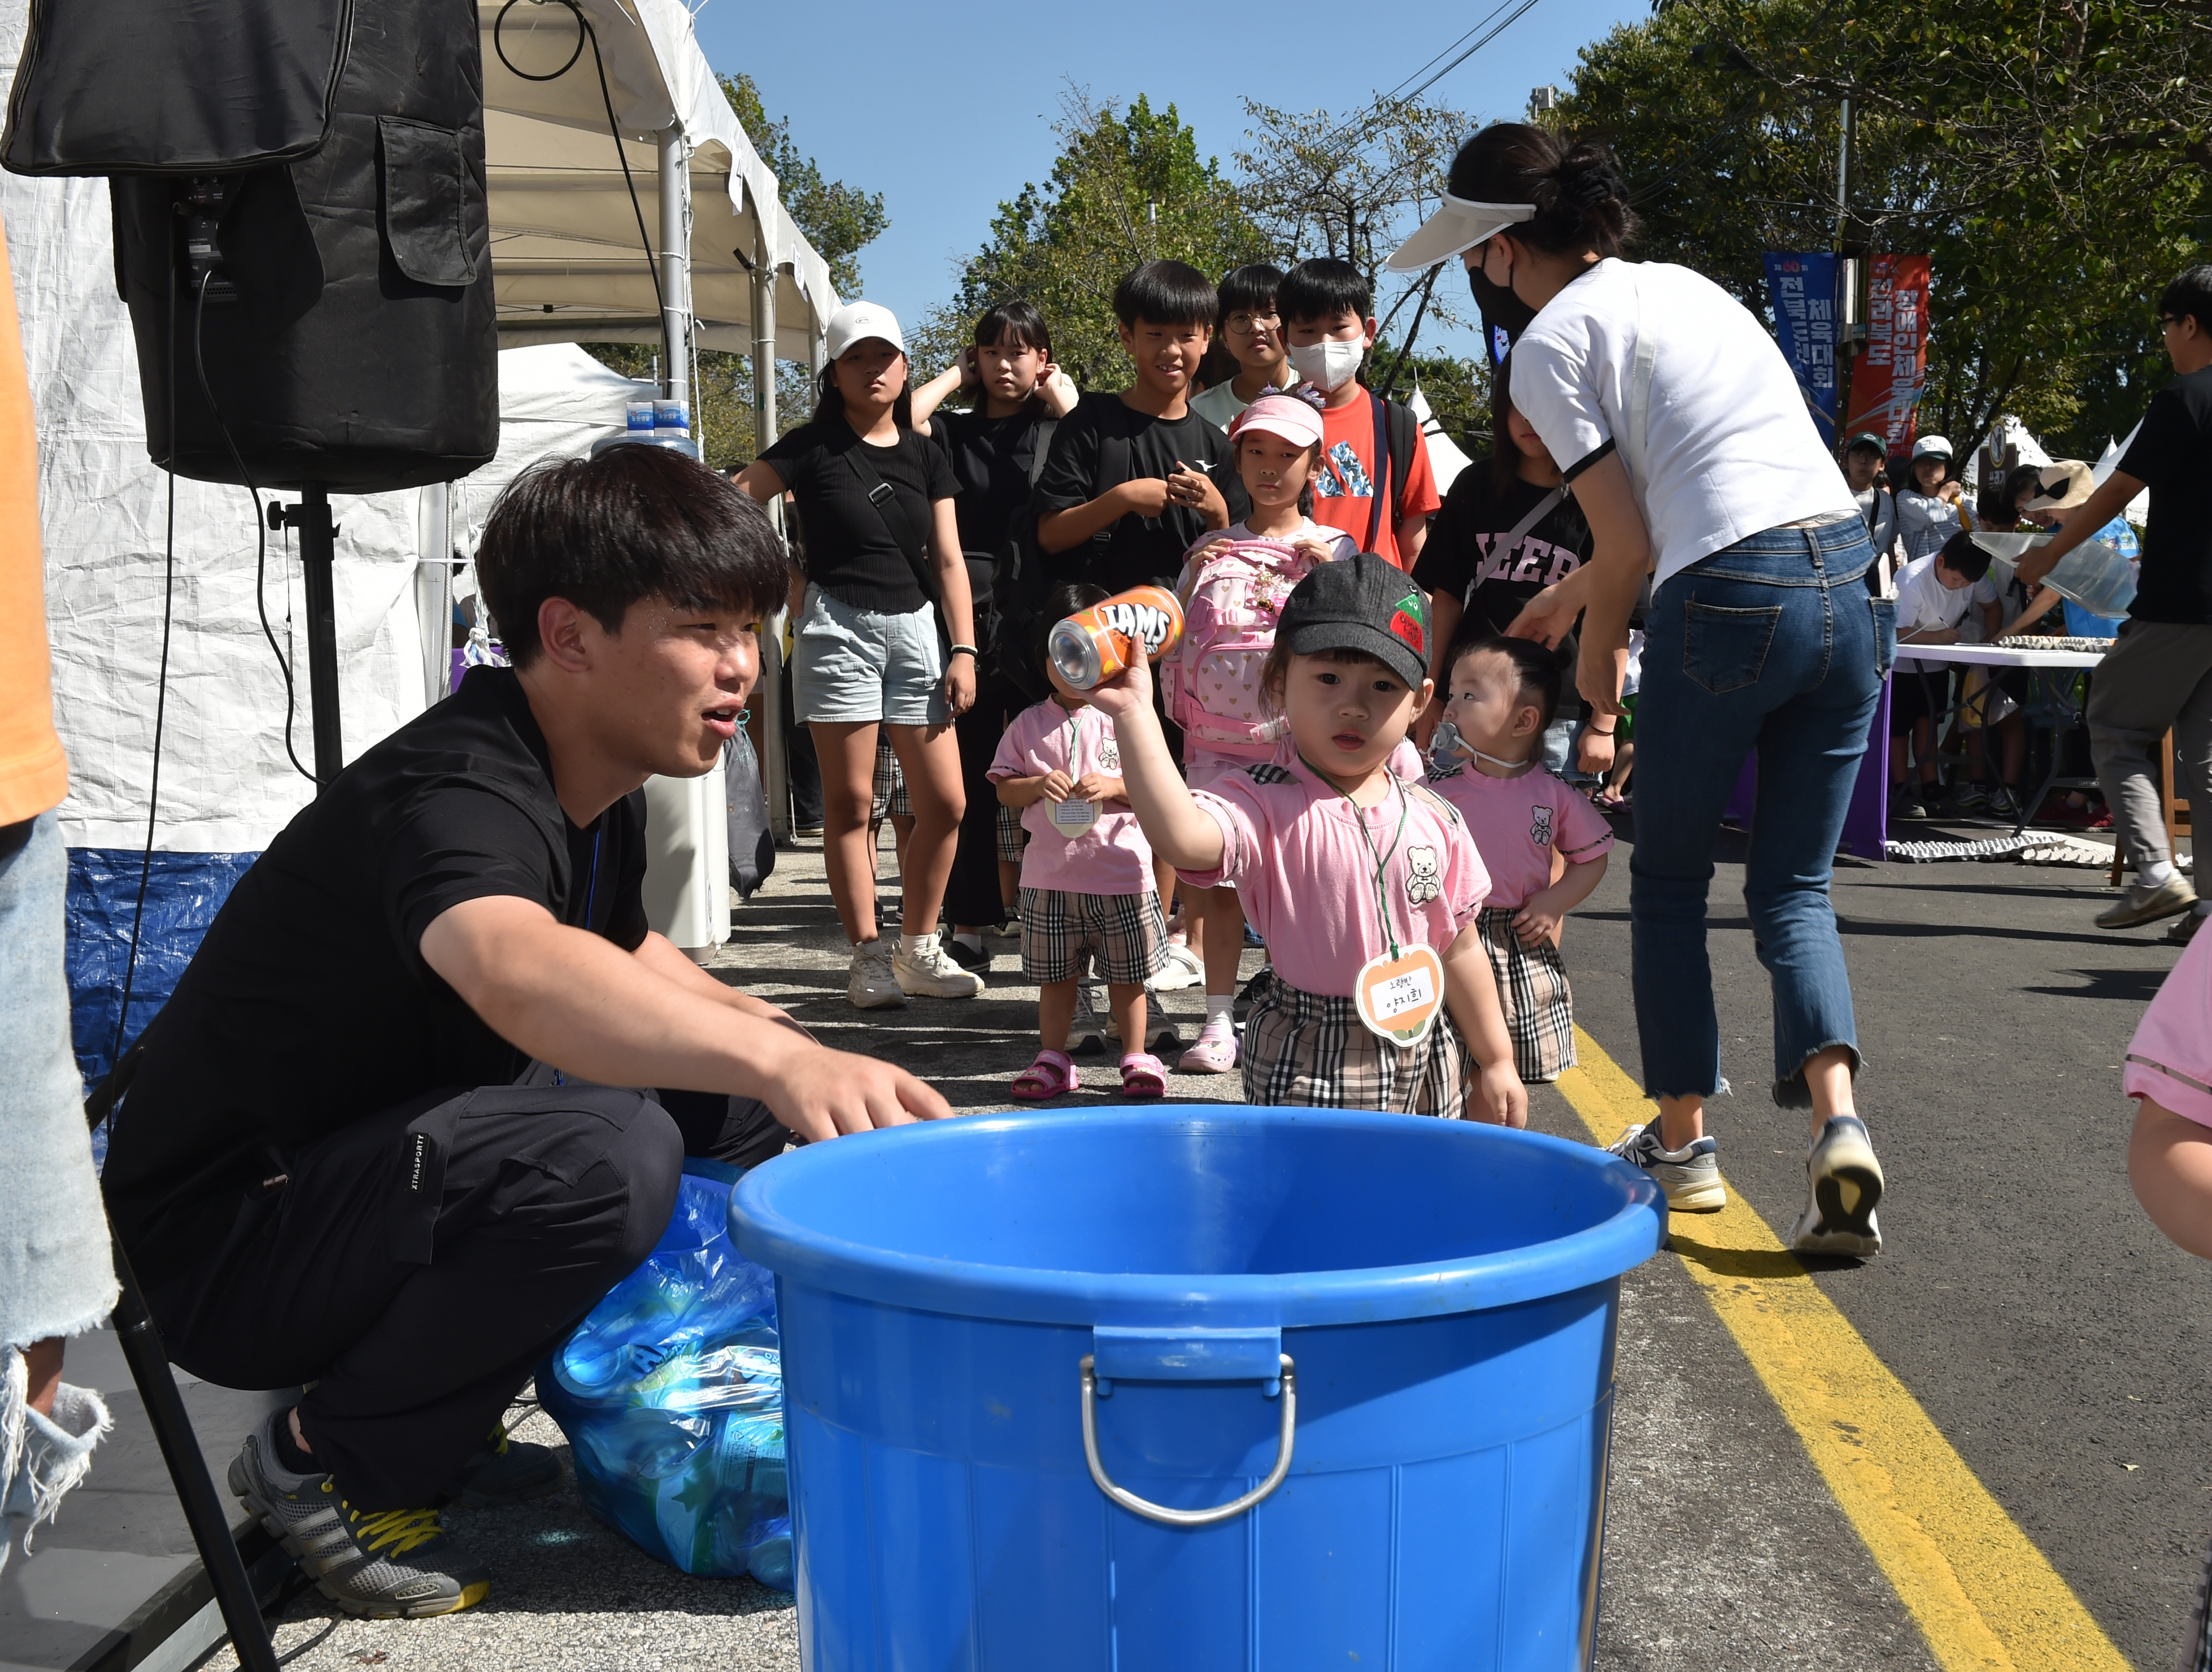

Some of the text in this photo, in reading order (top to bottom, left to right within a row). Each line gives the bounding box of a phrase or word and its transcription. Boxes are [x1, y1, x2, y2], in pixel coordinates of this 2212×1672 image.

[1780, 276, 1810, 365] 전북도민
[1808, 299, 1833, 388] 체육대회
[1867, 278, 1894, 365] 전라북도
[1886, 290, 1918, 444] 장애인체육대회
[1386, 988, 1422, 1013] 양지희
[1390, 975, 1412, 990] 노랑반
[411, 1134, 425, 1190] XTRASPORTY
